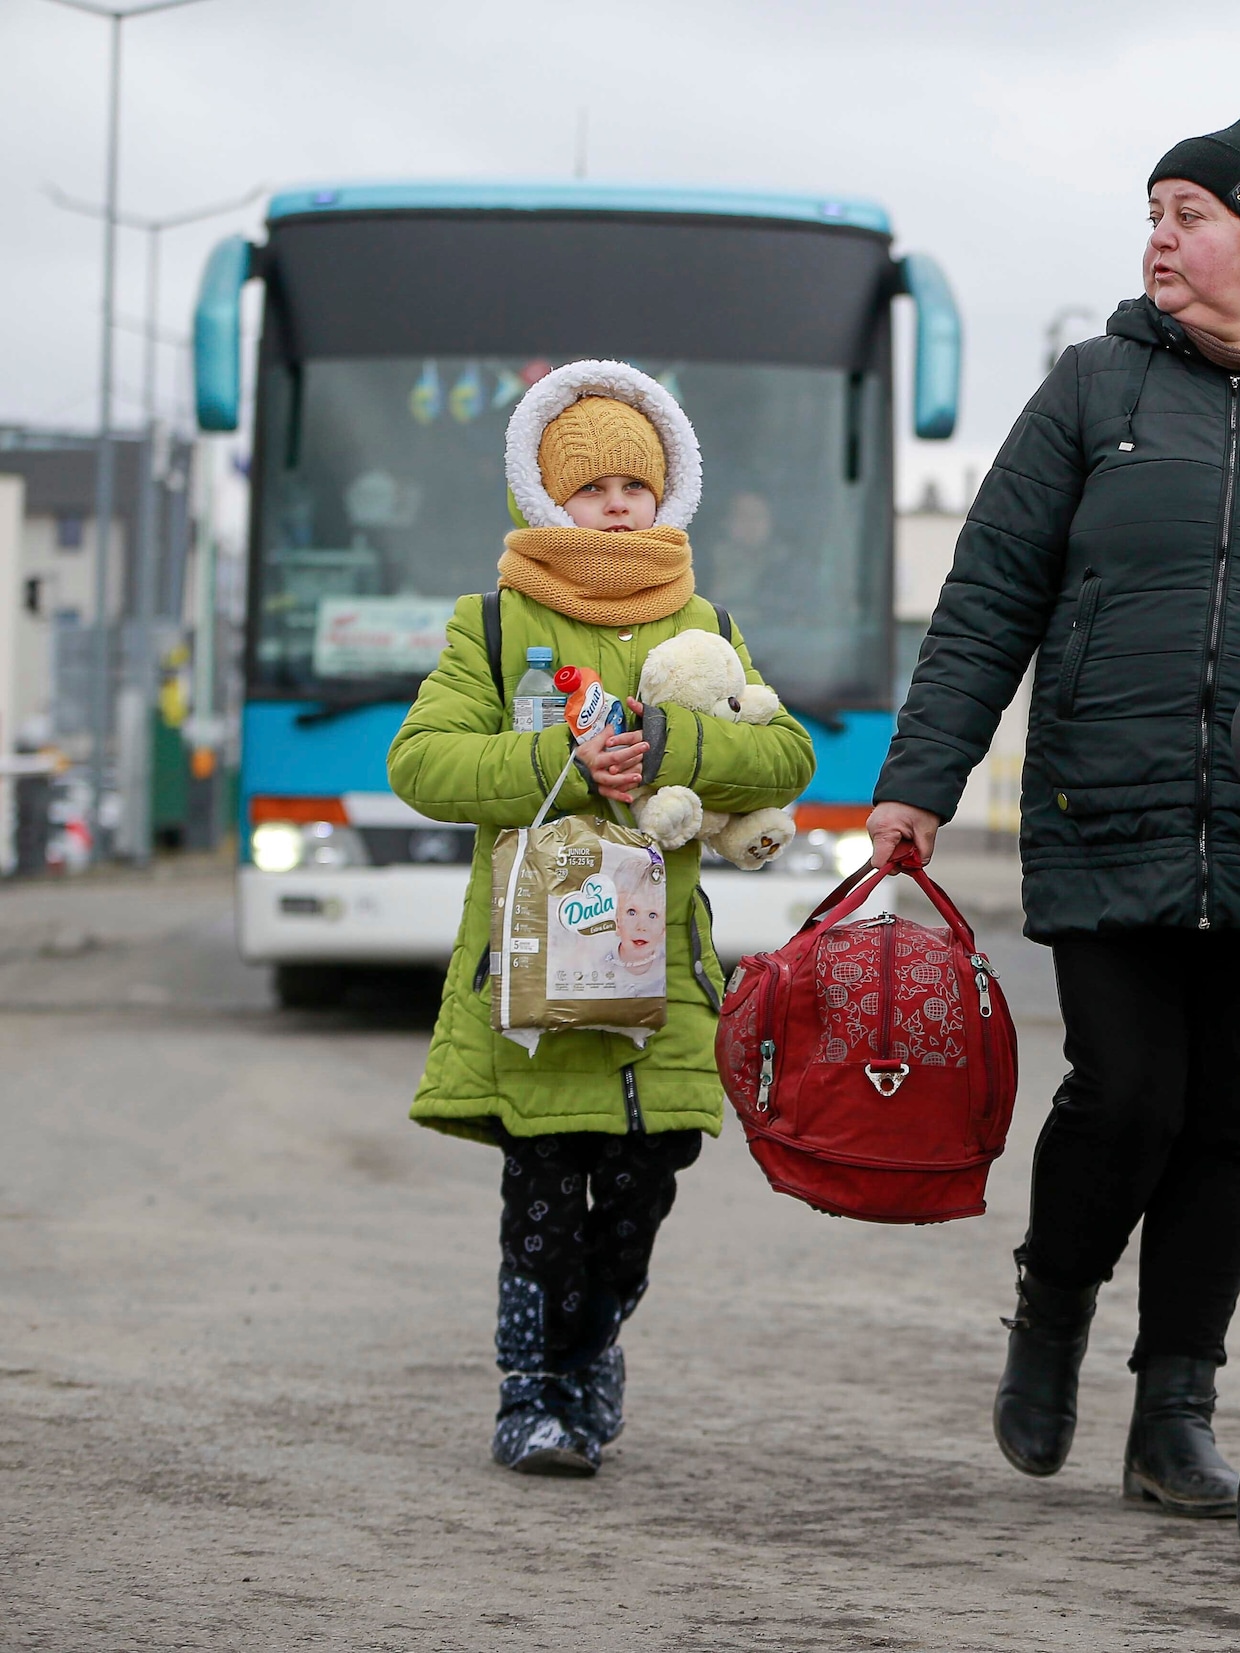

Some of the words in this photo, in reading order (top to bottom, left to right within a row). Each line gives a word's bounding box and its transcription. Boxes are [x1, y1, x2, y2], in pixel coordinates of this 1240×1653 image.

[580, 686, 601, 724] Sunar
[556, 846, 567, 867] 5
[568, 848, 590, 857] JUNIOR
[568, 858, 585, 866] 15-25
[586, 858, 594, 867] kg
[517, 887, 523, 897] 2
[515, 904, 521, 915] 3
[564, 893, 614, 926] Dada
[513, 922, 520, 932] 4
[513, 940, 519, 950] 5
[513, 957, 519, 968] 6
